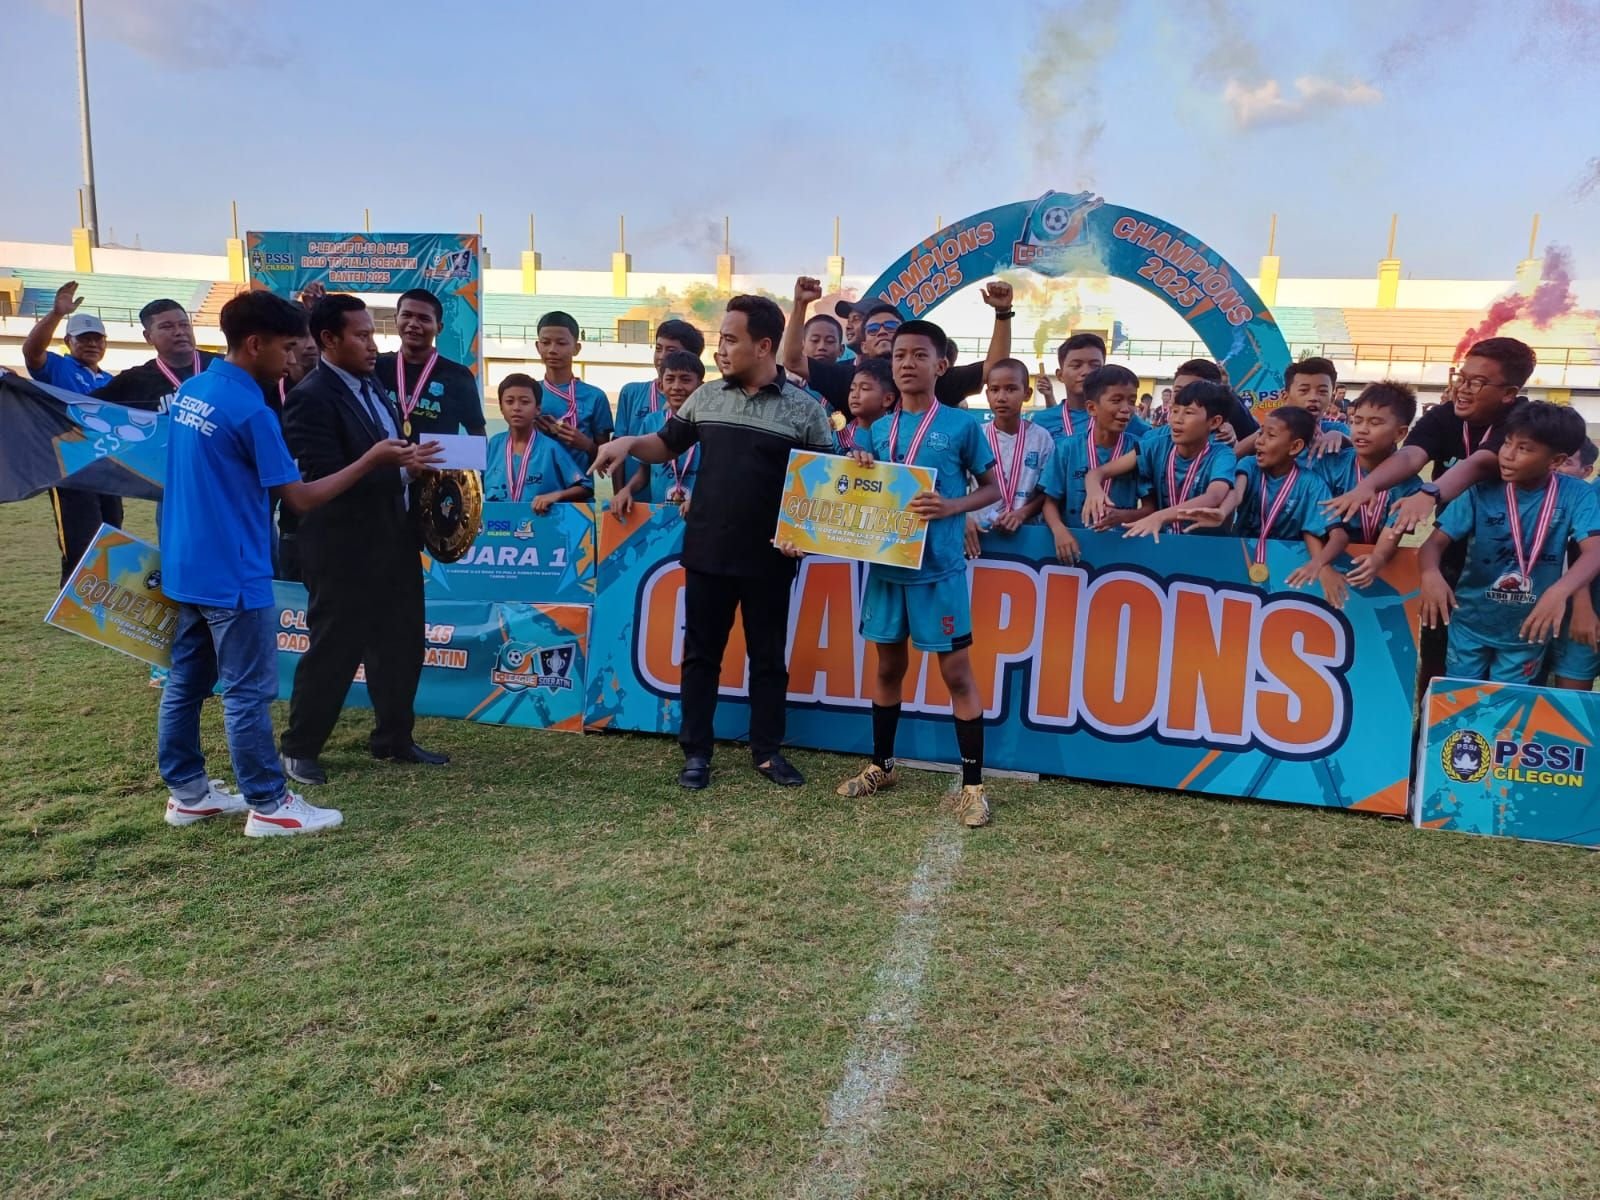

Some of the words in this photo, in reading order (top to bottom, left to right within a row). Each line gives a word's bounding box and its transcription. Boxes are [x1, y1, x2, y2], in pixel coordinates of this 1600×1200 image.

[265, 253, 295, 264] PSSI
[309, 242, 354, 254] C-LEAGUE
[377, 243, 386, 254] &
[302, 257, 326, 268] ROAD
[328, 257, 341, 269] TO
[342, 257, 369, 268] PIALA
[370, 258, 417, 269] SOERATIN
[879, 222, 995, 306] AMPIONS
[1113, 217, 1253, 326] CHAMPIONS
[329, 271, 367, 283] BANTEN
[367, 272, 391, 283] 2025
[1137, 257, 1206, 306] 2025
[907, 262, 963, 317] 2025
[853, 478, 882, 493] PSSI
[488, 520, 511, 531] PSSI
[785, 496, 857, 527] GOLDEN
[858, 505, 921, 537] TICKET
[456, 546, 539, 567] UARA
[549, 548, 568, 567] 1
[74, 573, 163, 628] GOLDEN
[425, 623, 455, 644] -15
[942, 615, 955, 636] 5
[277, 632, 310, 653] OAD
[424, 648, 468, 669] ATIN
[539, 677, 572, 688] SOERATIN
[1495, 739, 1586, 773] PSSI
[1493, 767, 1584, 787] CILEGON
